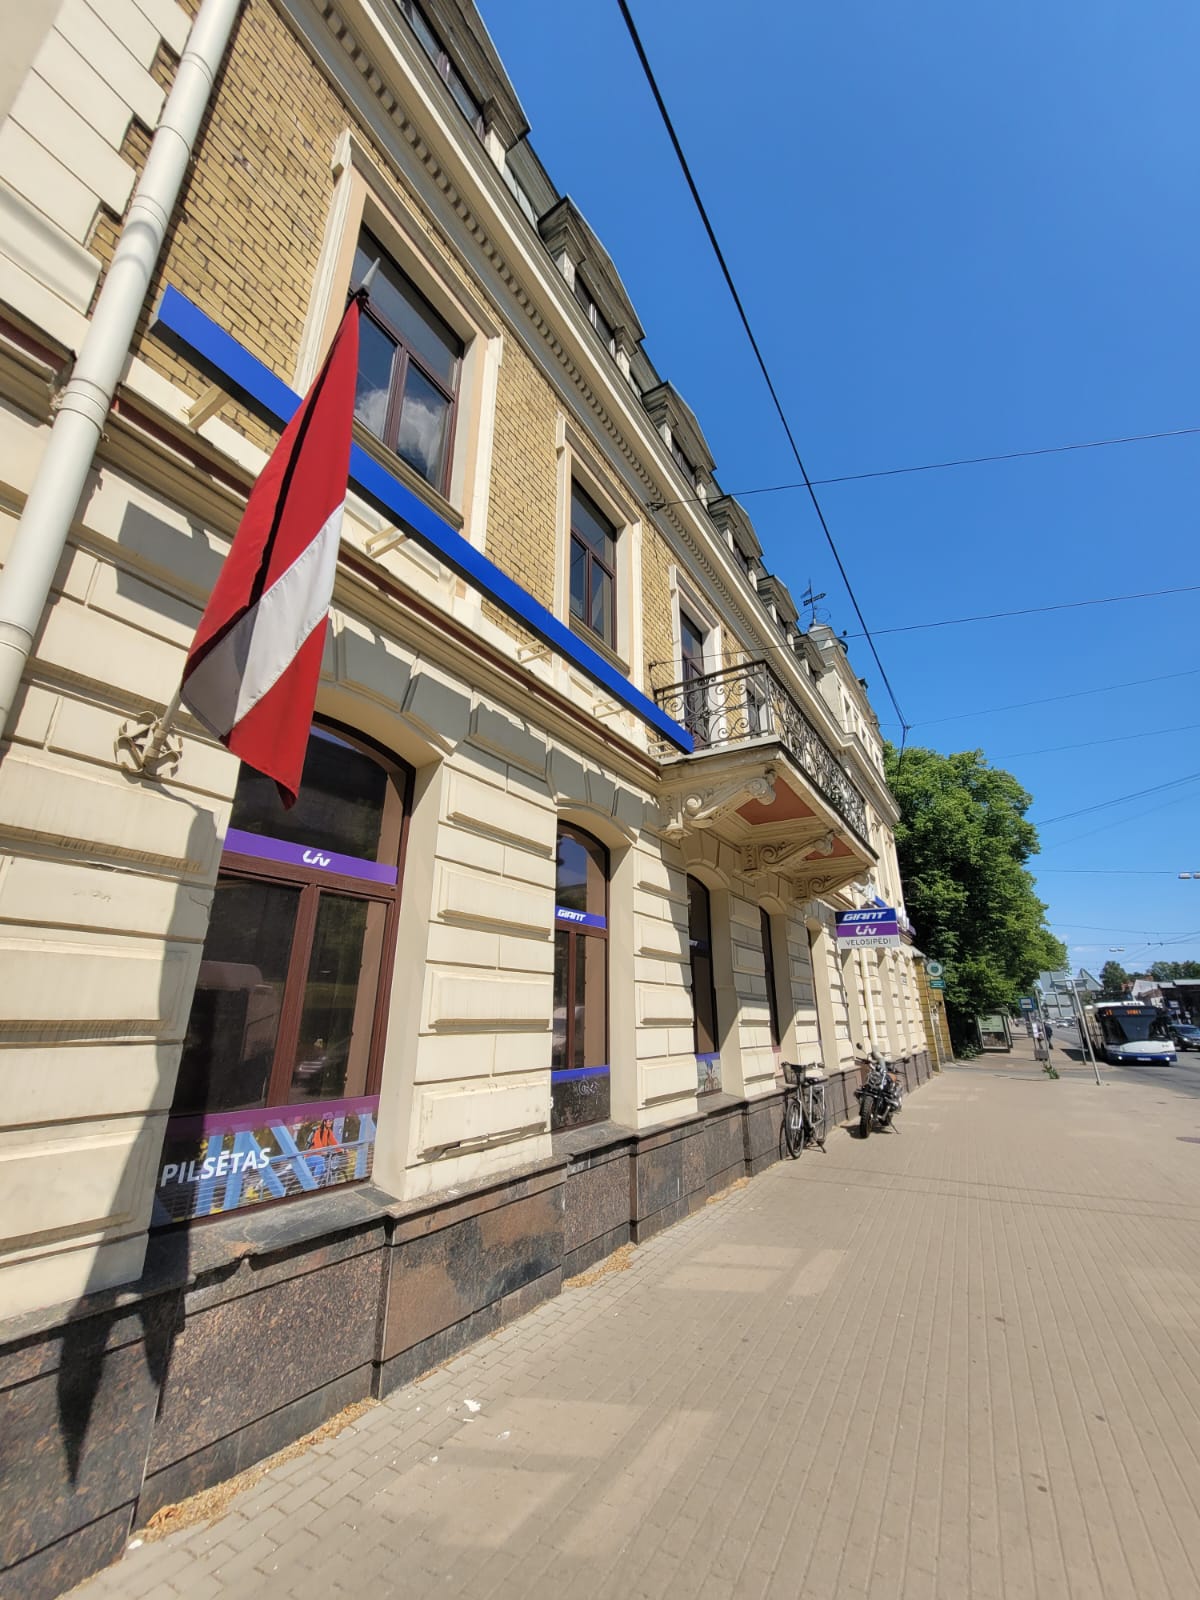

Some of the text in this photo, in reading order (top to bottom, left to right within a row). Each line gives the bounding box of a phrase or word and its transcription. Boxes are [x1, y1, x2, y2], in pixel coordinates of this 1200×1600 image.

[302, 850, 331, 867] Liv
[557, 909, 586, 922] GIANT
[843, 911, 887, 922] GIANT
[855, 925, 878, 935] Liv
[160, 1147, 271, 1188] PILSĒTAS
